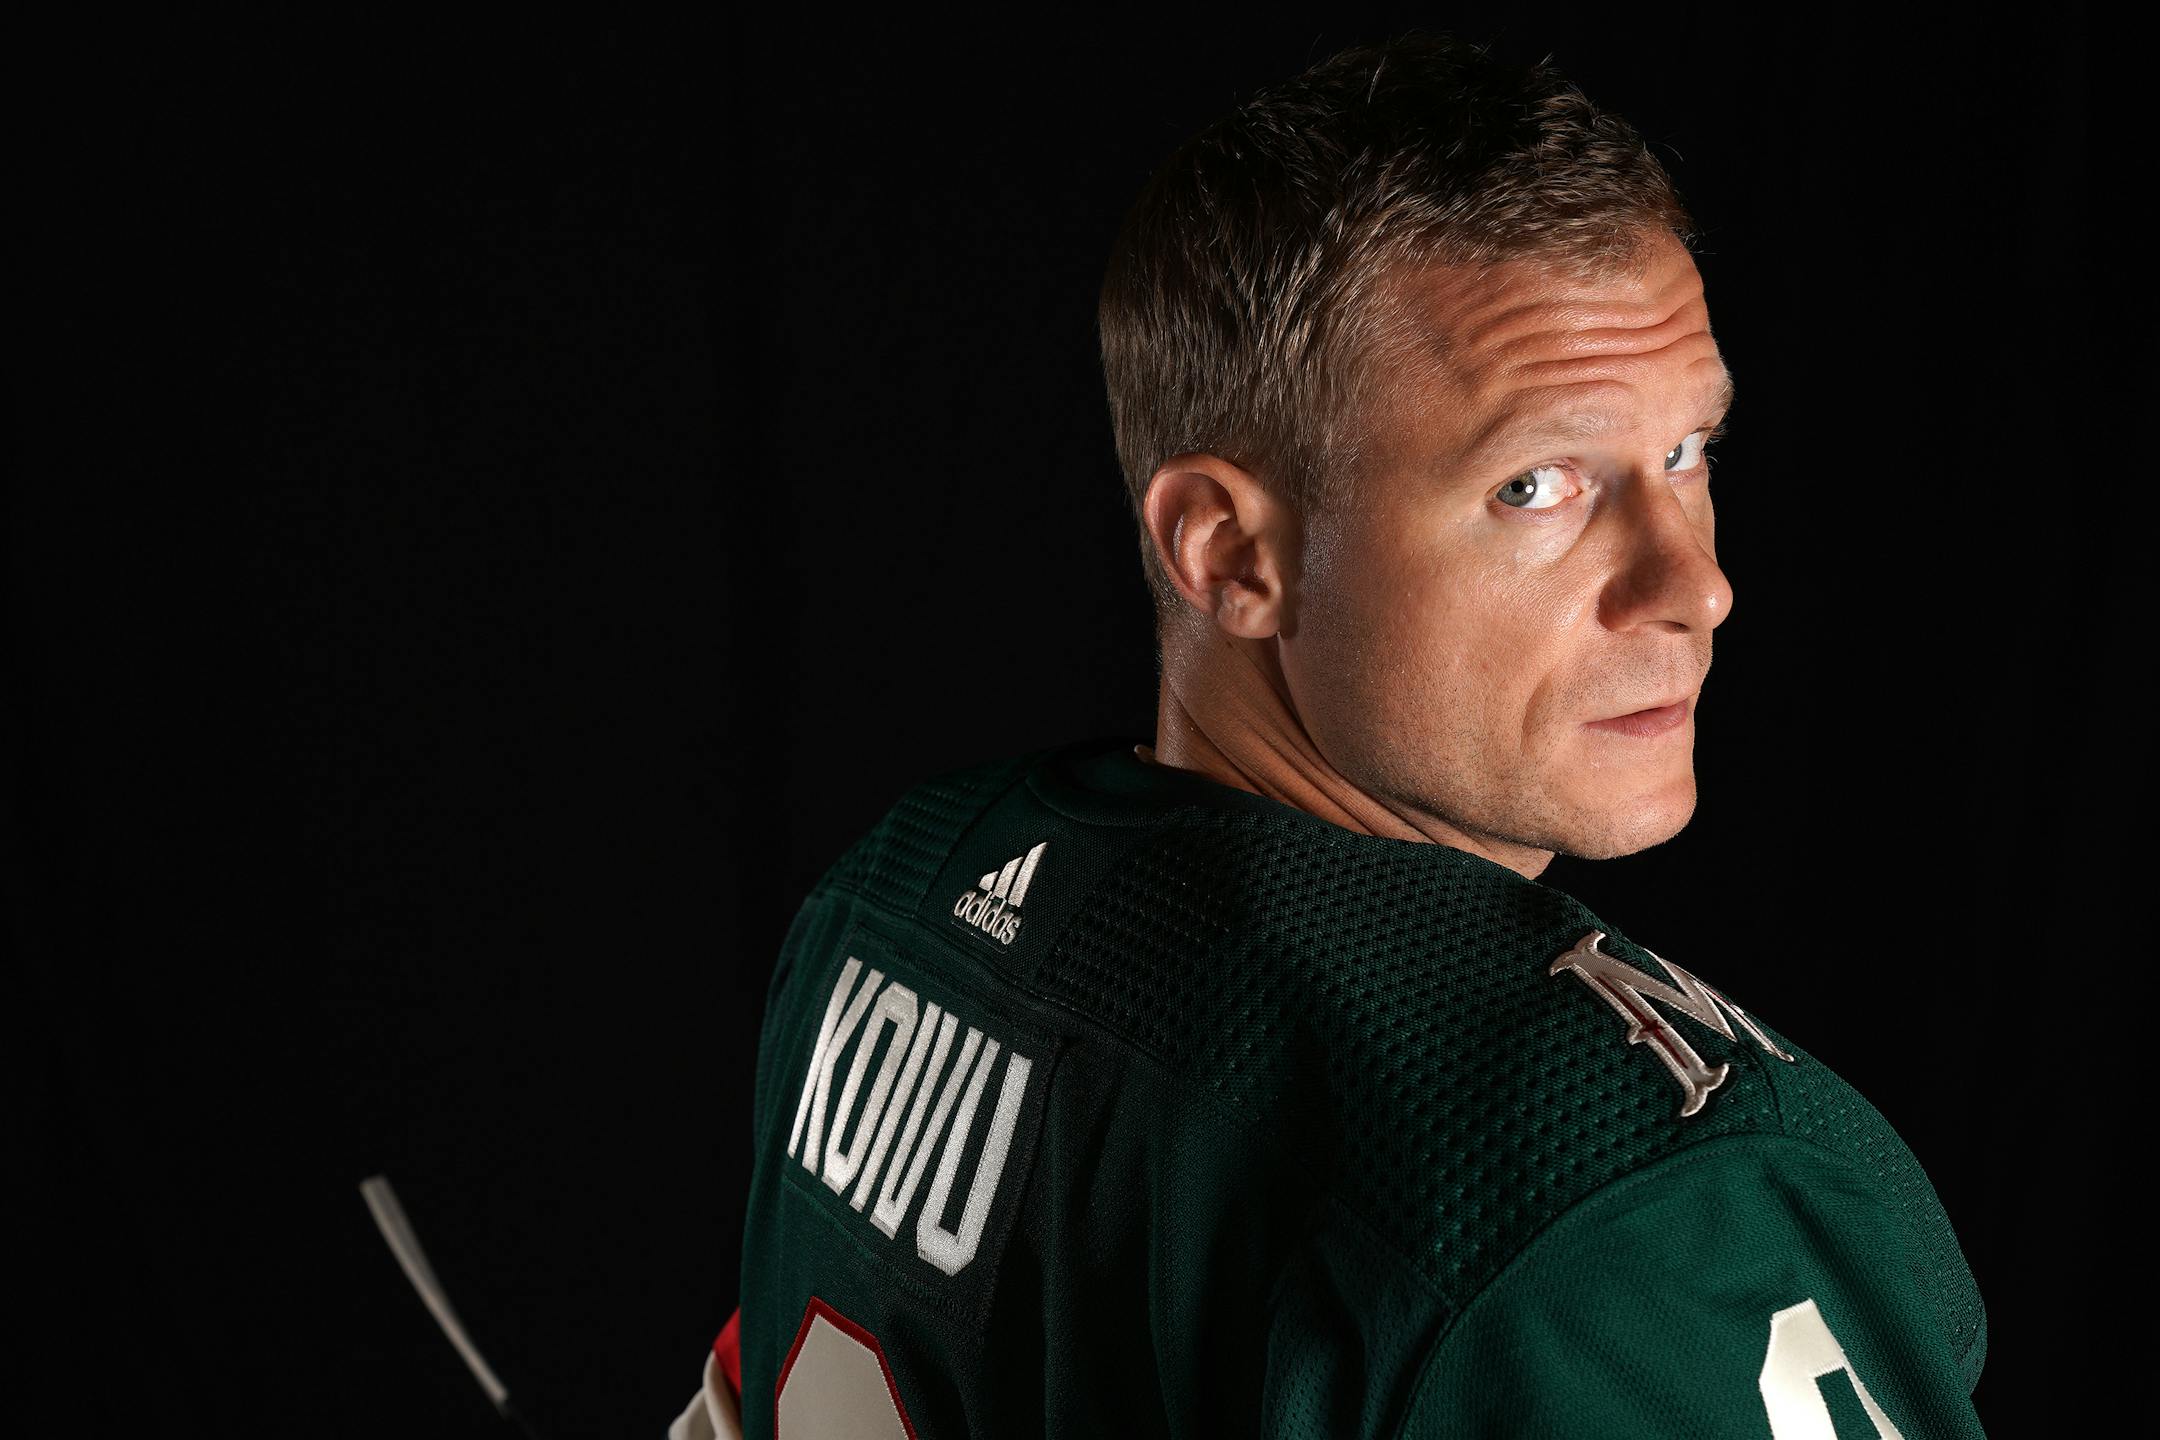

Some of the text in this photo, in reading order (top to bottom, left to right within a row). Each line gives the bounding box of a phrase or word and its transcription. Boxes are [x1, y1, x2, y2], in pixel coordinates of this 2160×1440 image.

[952, 889, 1023, 945] adidas
[787, 956, 1032, 1277] KOIVU
[1548, 929, 1795, 1118] M
